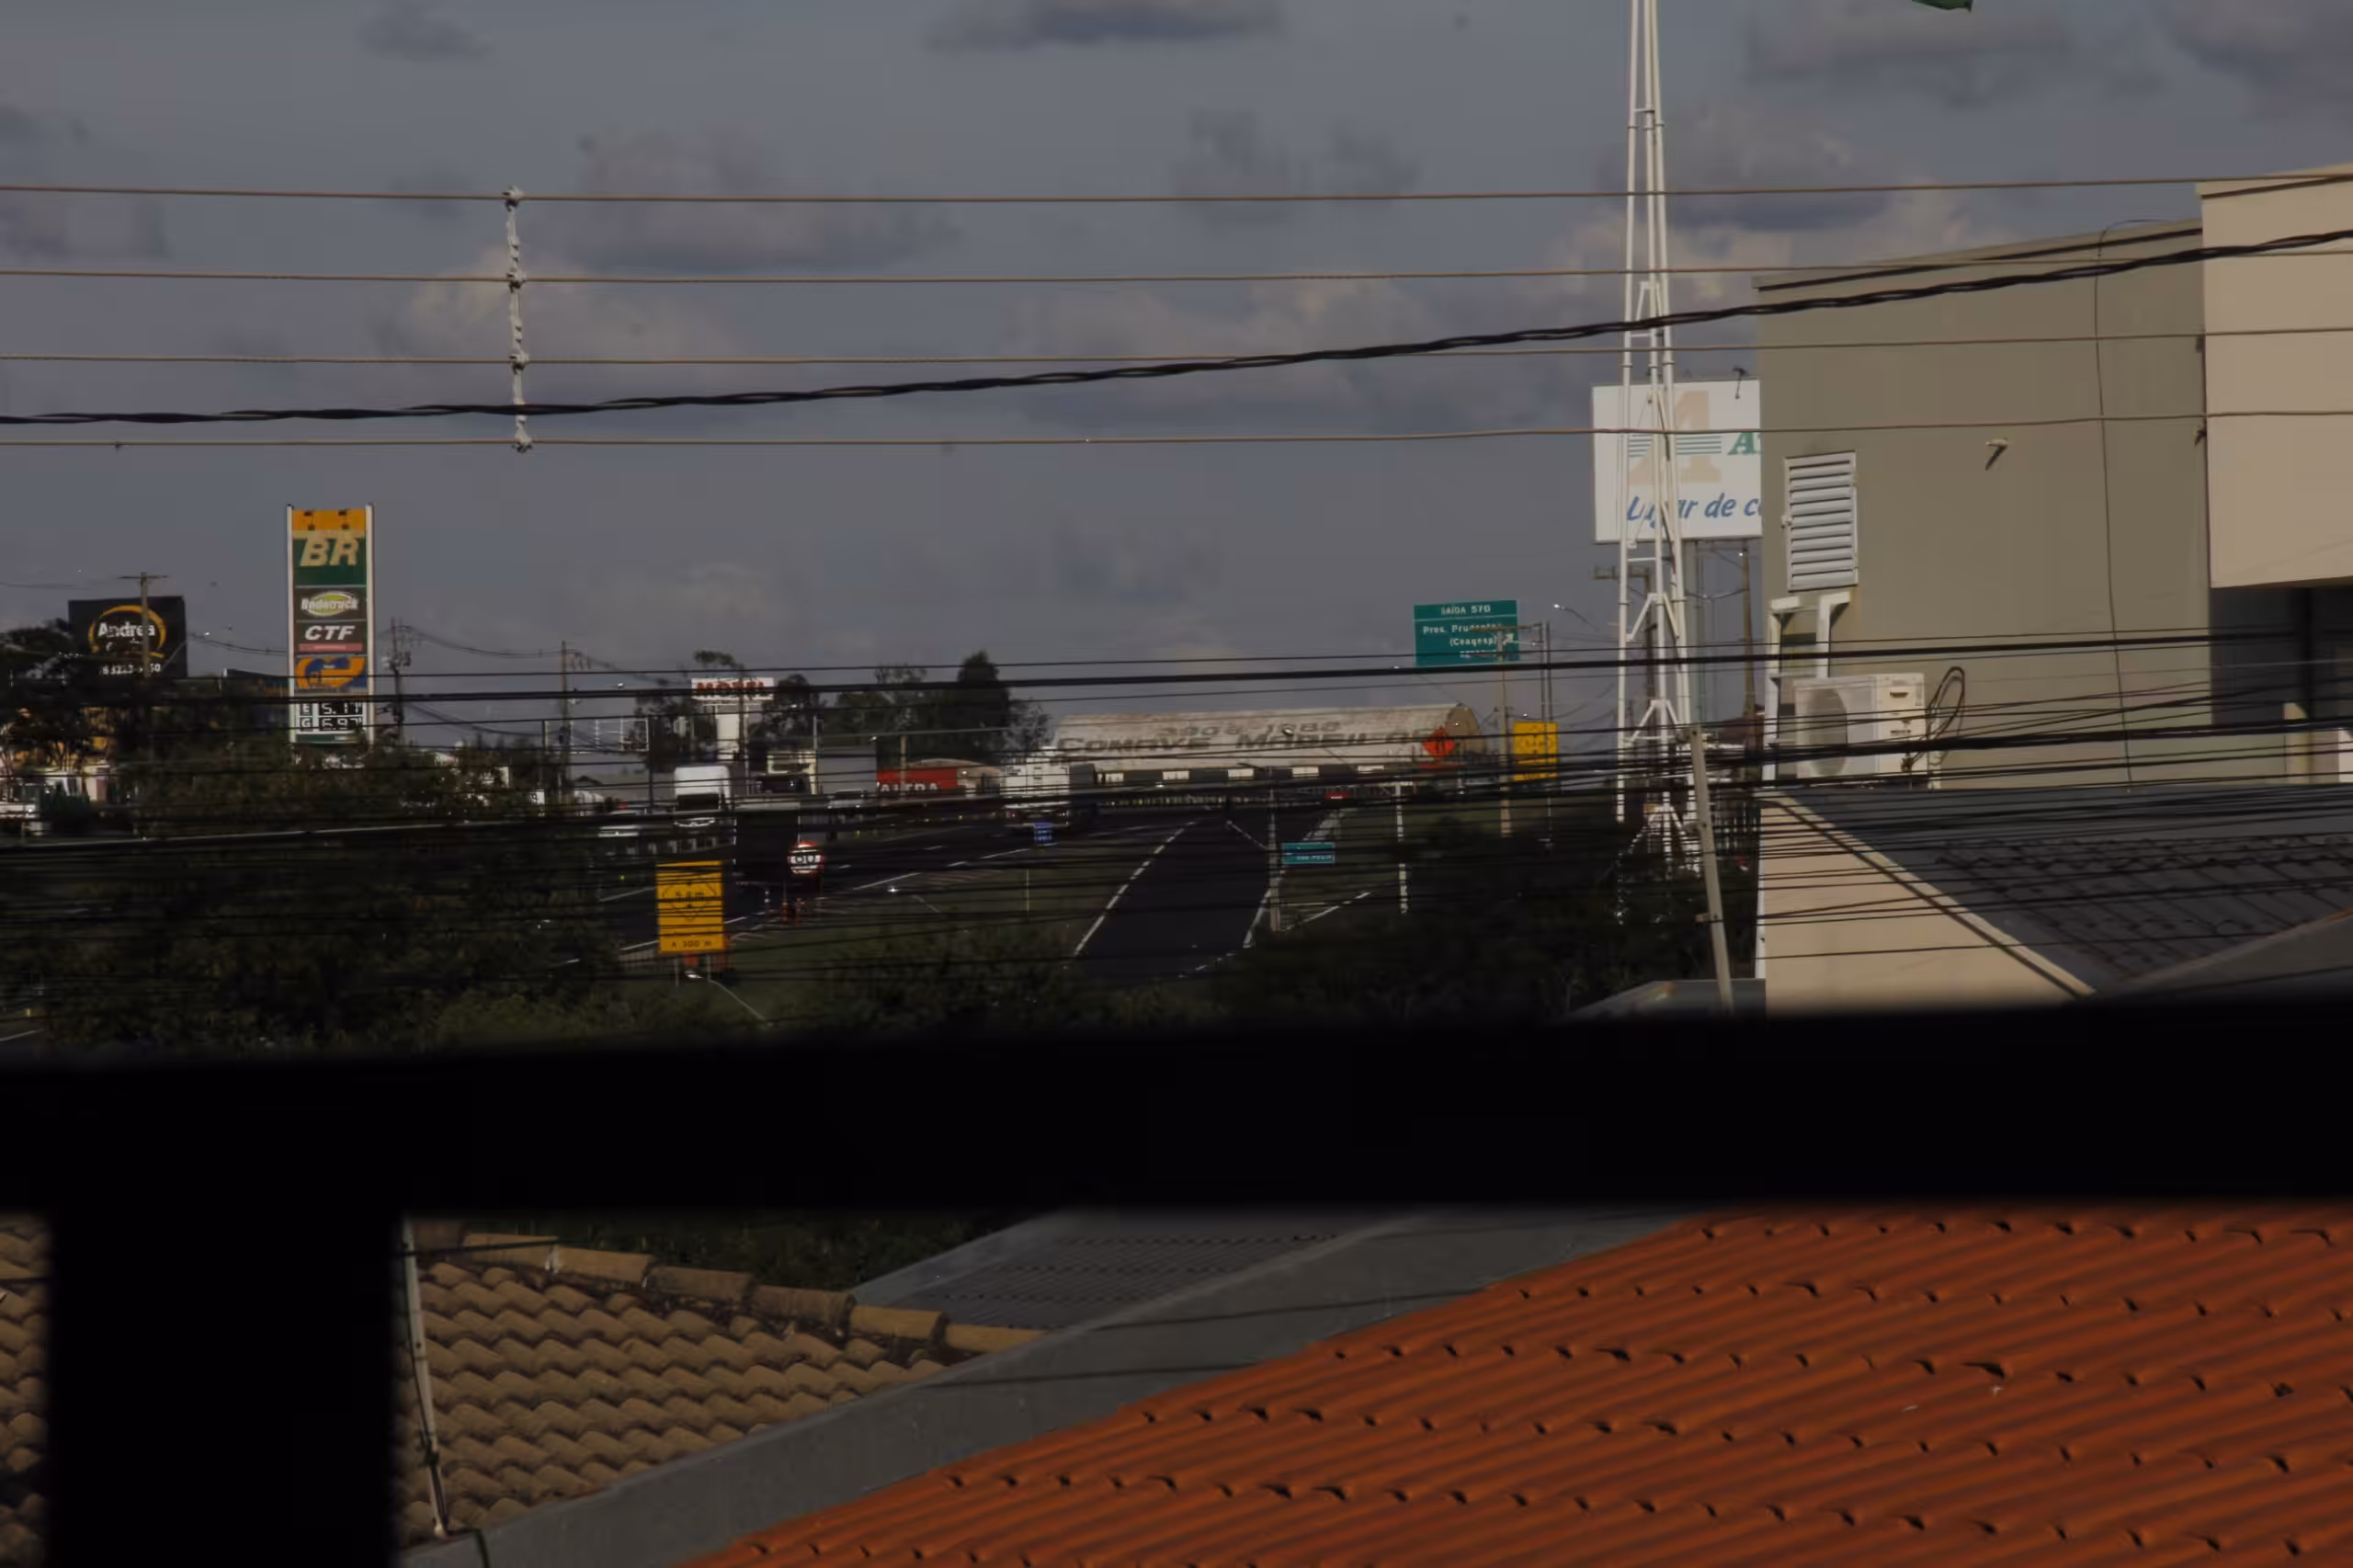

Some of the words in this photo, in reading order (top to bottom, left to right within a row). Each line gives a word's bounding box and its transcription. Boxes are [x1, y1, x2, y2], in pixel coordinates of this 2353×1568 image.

[1626, 495, 1699, 528] Luar
[1704, 492, 1736, 518] de
[1744, 498, 1761, 517] c
[300, 538, 359, 567] BR
[304, 625, 356, 641] CTF
